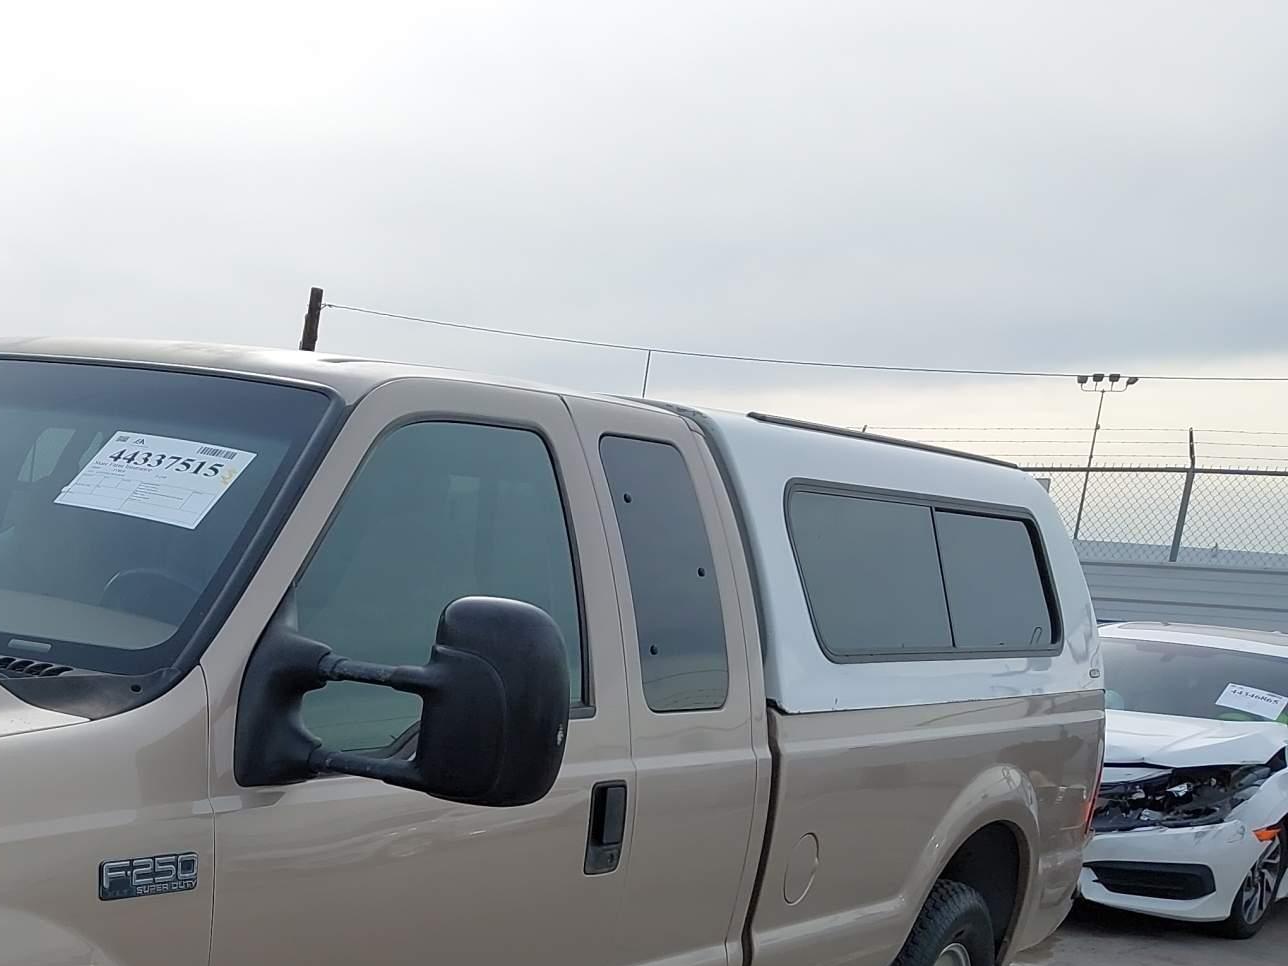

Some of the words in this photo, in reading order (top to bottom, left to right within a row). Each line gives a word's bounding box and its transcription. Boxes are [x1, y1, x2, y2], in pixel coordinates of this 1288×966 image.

[108, 449, 225, 477] 44337515
[136, 883, 169, 894] SUPER
[171, 880, 197, 889] DUTY
